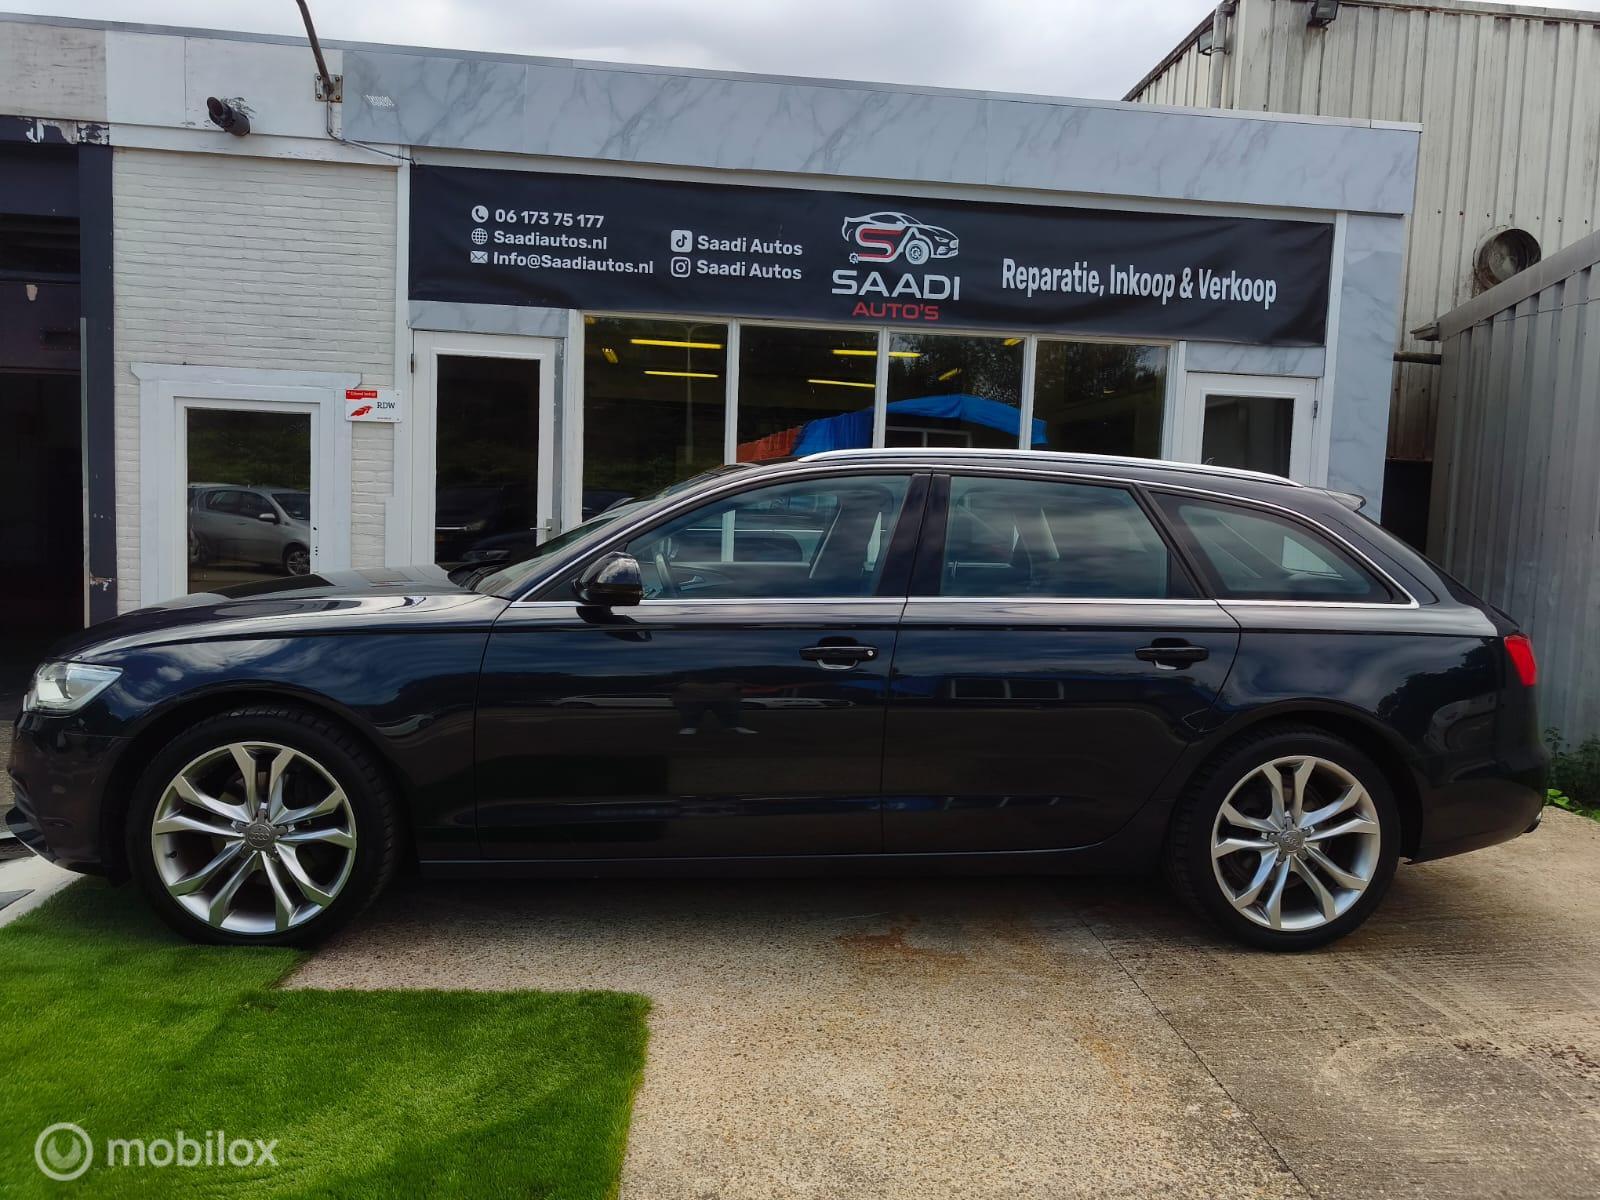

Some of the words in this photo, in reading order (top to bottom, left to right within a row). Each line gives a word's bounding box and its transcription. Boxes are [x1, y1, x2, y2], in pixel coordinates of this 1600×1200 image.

[495, 208, 517, 223] 06
[520, 210, 549, 226] 173
[553, 212, 573, 227] 75
[576, 214, 604, 228] 177
[493, 230, 607, 249] Saadiautos.nl
[697, 235, 747, 253] Saadi
[750, 239, 803, 256] Autos
[493, 251, 654, 273] Info@Saadiautos.nl
[696, 260, 746, 277] Saadi
[749, 263, 802, 280] Autos
[831, 269, 961, 301] SAADI
[1001, 257, 1105, 298] Reparatie,
[1109, 264, 1176, 305] Inkoop
[1179, 267, 1194, 299] &
[1198, 269, 1278, 310] Verkoop
[852, 301, 940, 320] AUTO'S
[376, 401, 396, 409] RDW
